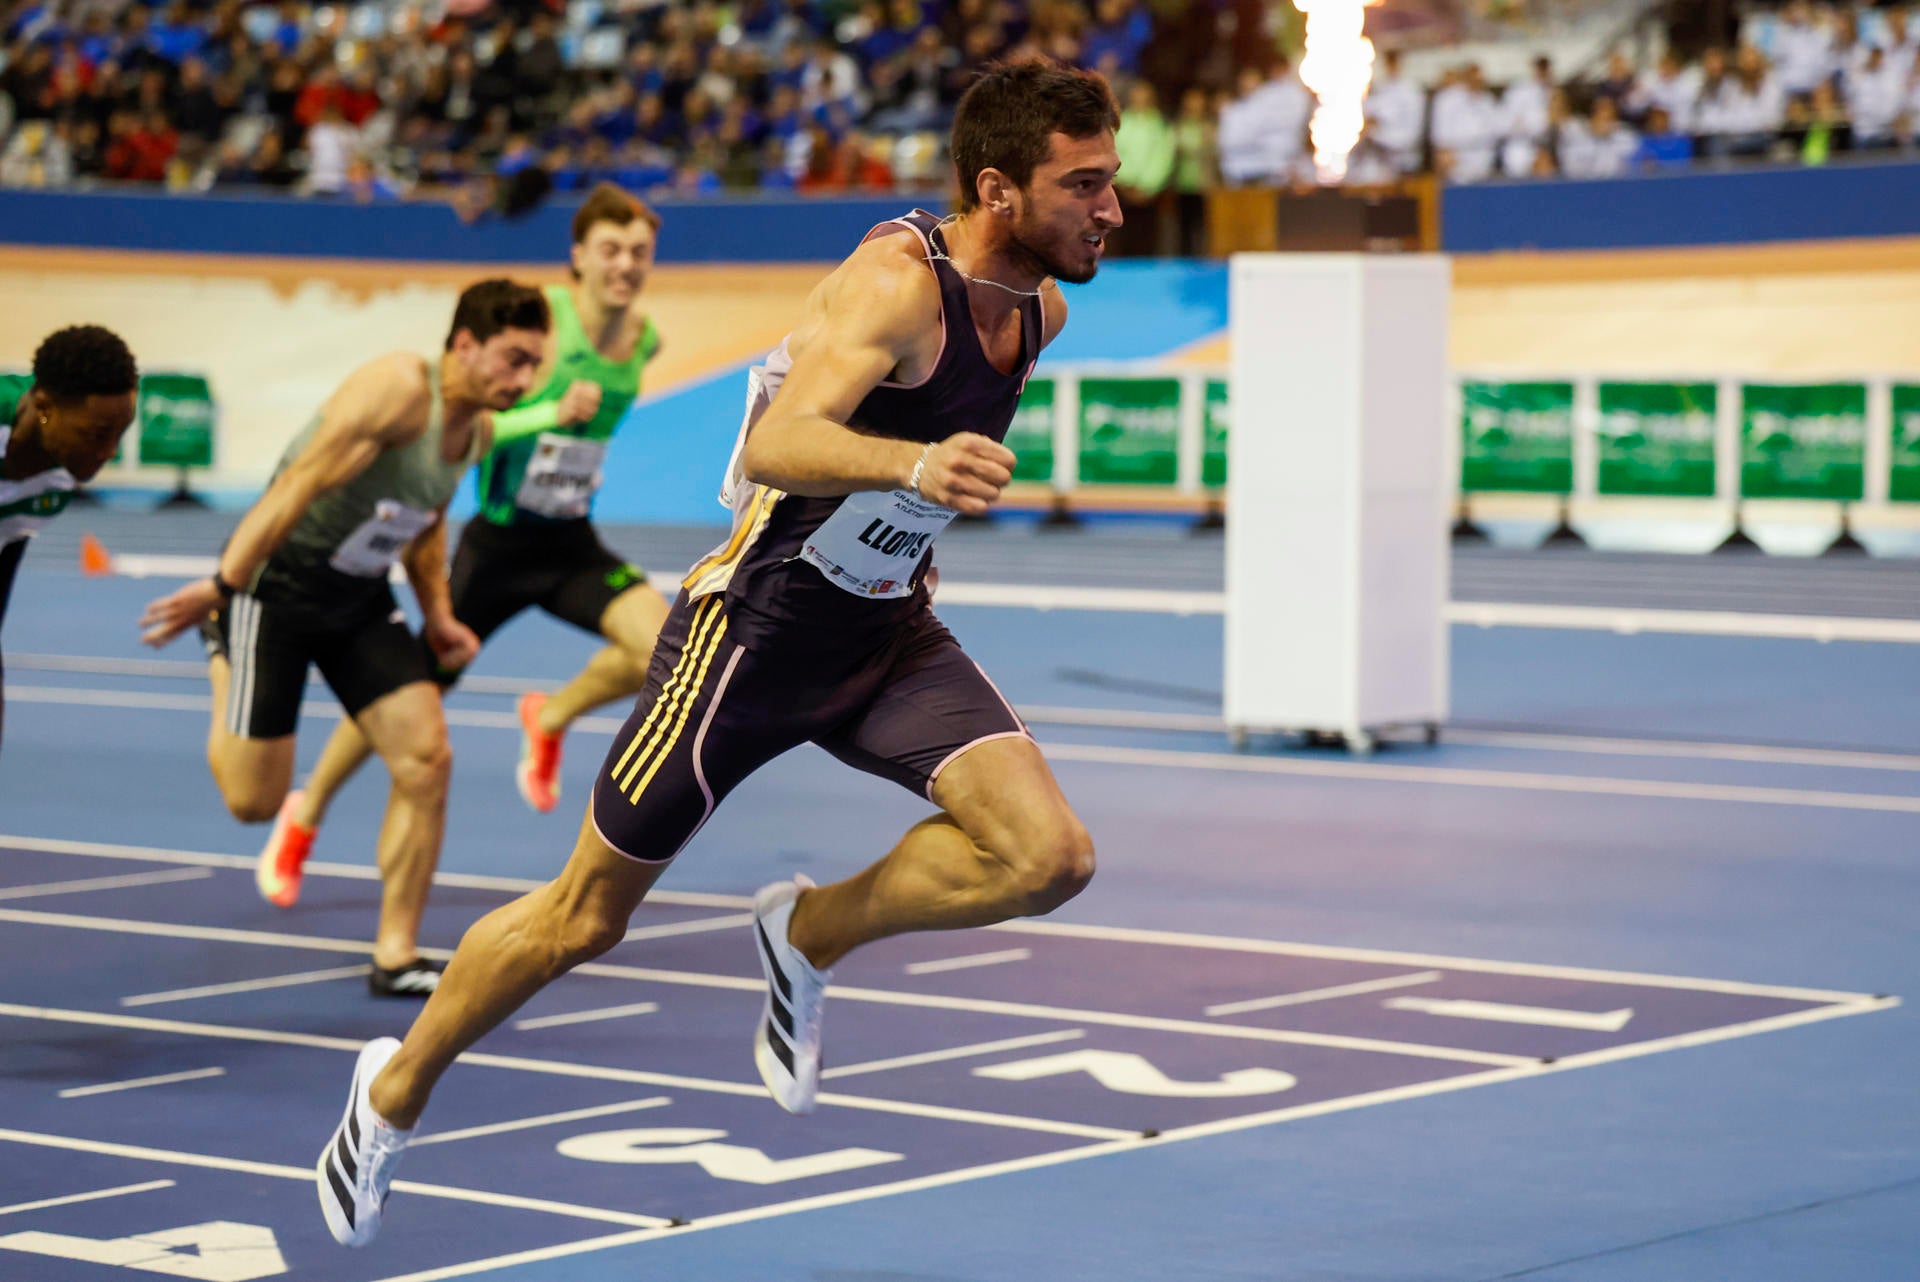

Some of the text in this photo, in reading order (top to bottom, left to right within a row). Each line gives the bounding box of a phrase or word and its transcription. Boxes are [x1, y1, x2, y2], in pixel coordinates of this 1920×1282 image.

[894, 491, 916, 507] GRAN
[857, 517, 932, 559] LLOPIS
[1382, 995, 1635, 1033] 1
[971, 1048, 1298, 1098] 2
[556, 1126, 906, 1184] 3
[0, 1220, 289, 1282] 4
